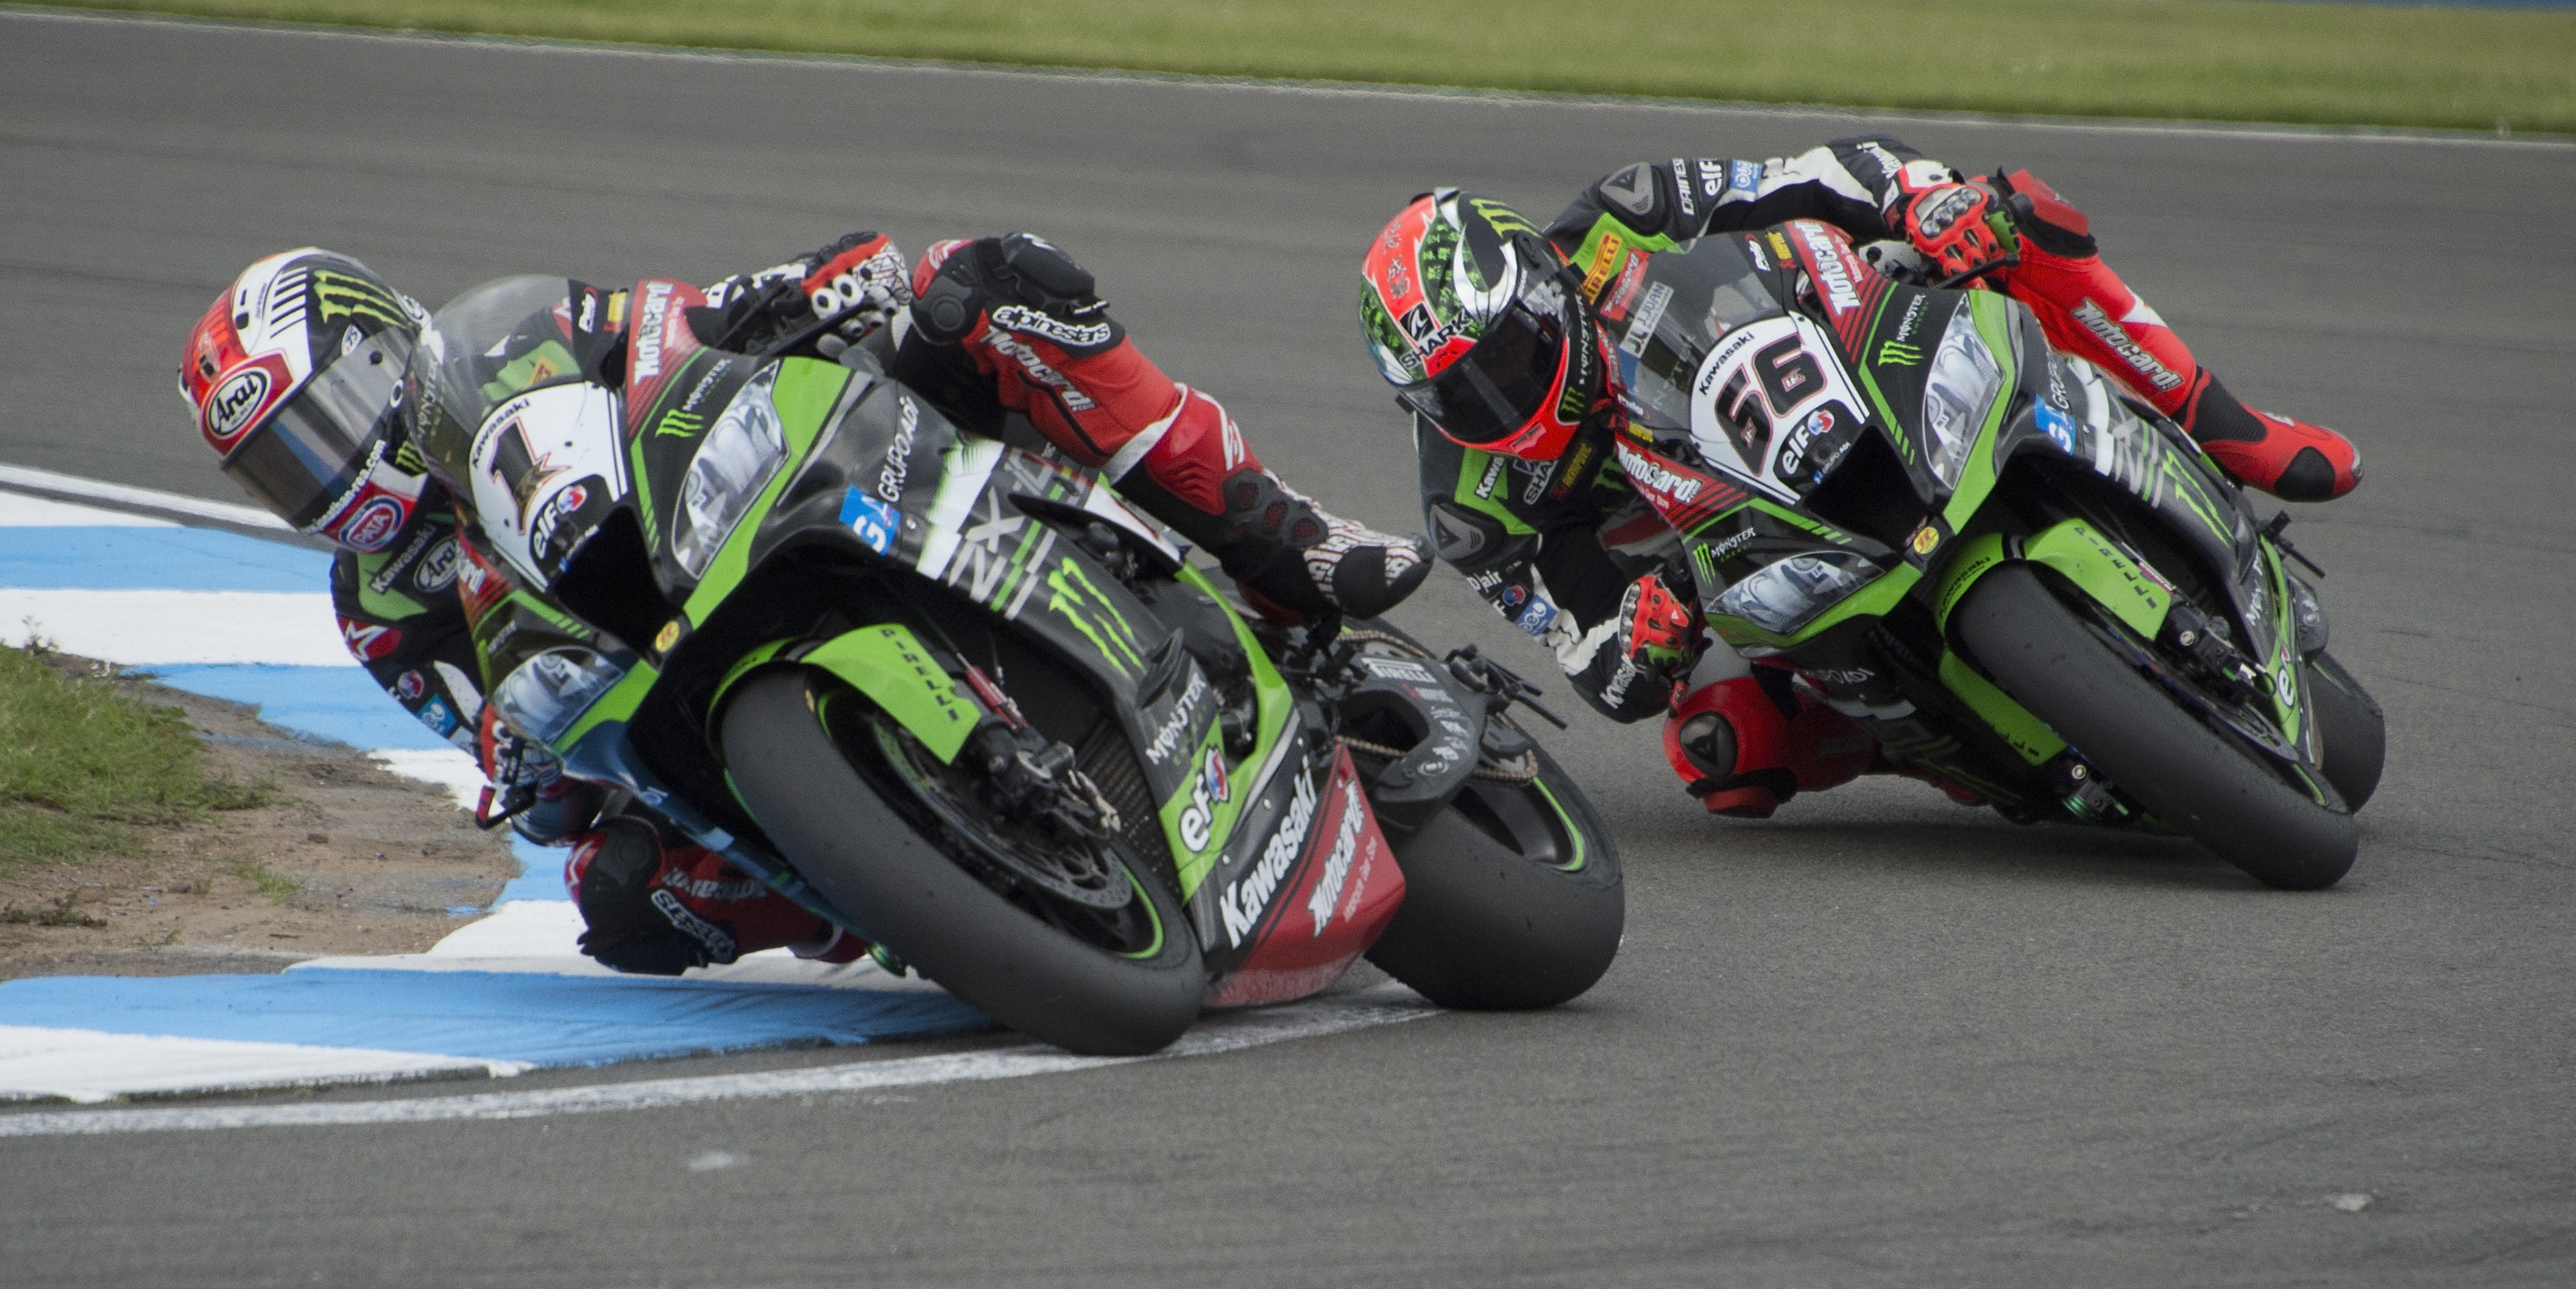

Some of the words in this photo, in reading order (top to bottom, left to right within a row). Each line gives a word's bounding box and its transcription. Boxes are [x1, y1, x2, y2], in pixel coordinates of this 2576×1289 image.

[1672, 157, 1694, 216] DAINES
[1699, 160, 1722, 196] elf
[993, 305, 1111, 347] alpinestars
[1399, 310, 1470, 367] SHARK
[1896, 294, 1927, 343] MONSTER
[1699, 331, 1755, 396] Kawasaki
[213, 372, 258, 434] Arai
[1714, 331, 1827, 478] 66
[473, 397, 530, 469] Kawasaki
[1783, 425, 1811, 475] elf
[487, 415, 573, 536] 1
[1476, 456, 1505, 498] Kawa
[1526, 461, 1554, 503] SHA
[351, 514, 392, 544] PATA
[371, 523, 437, 593] Kawasaki
[533, 502, 559, 560] elf
[1711, 527, 1756, 560] MONSTER
[416, 543, 458, 589] Ara
[1145, 672, 1206, 765] MONSTER
[1180, 773, 1211, 853] elf
[1219, 755, 1317, 950] Kawasaki
